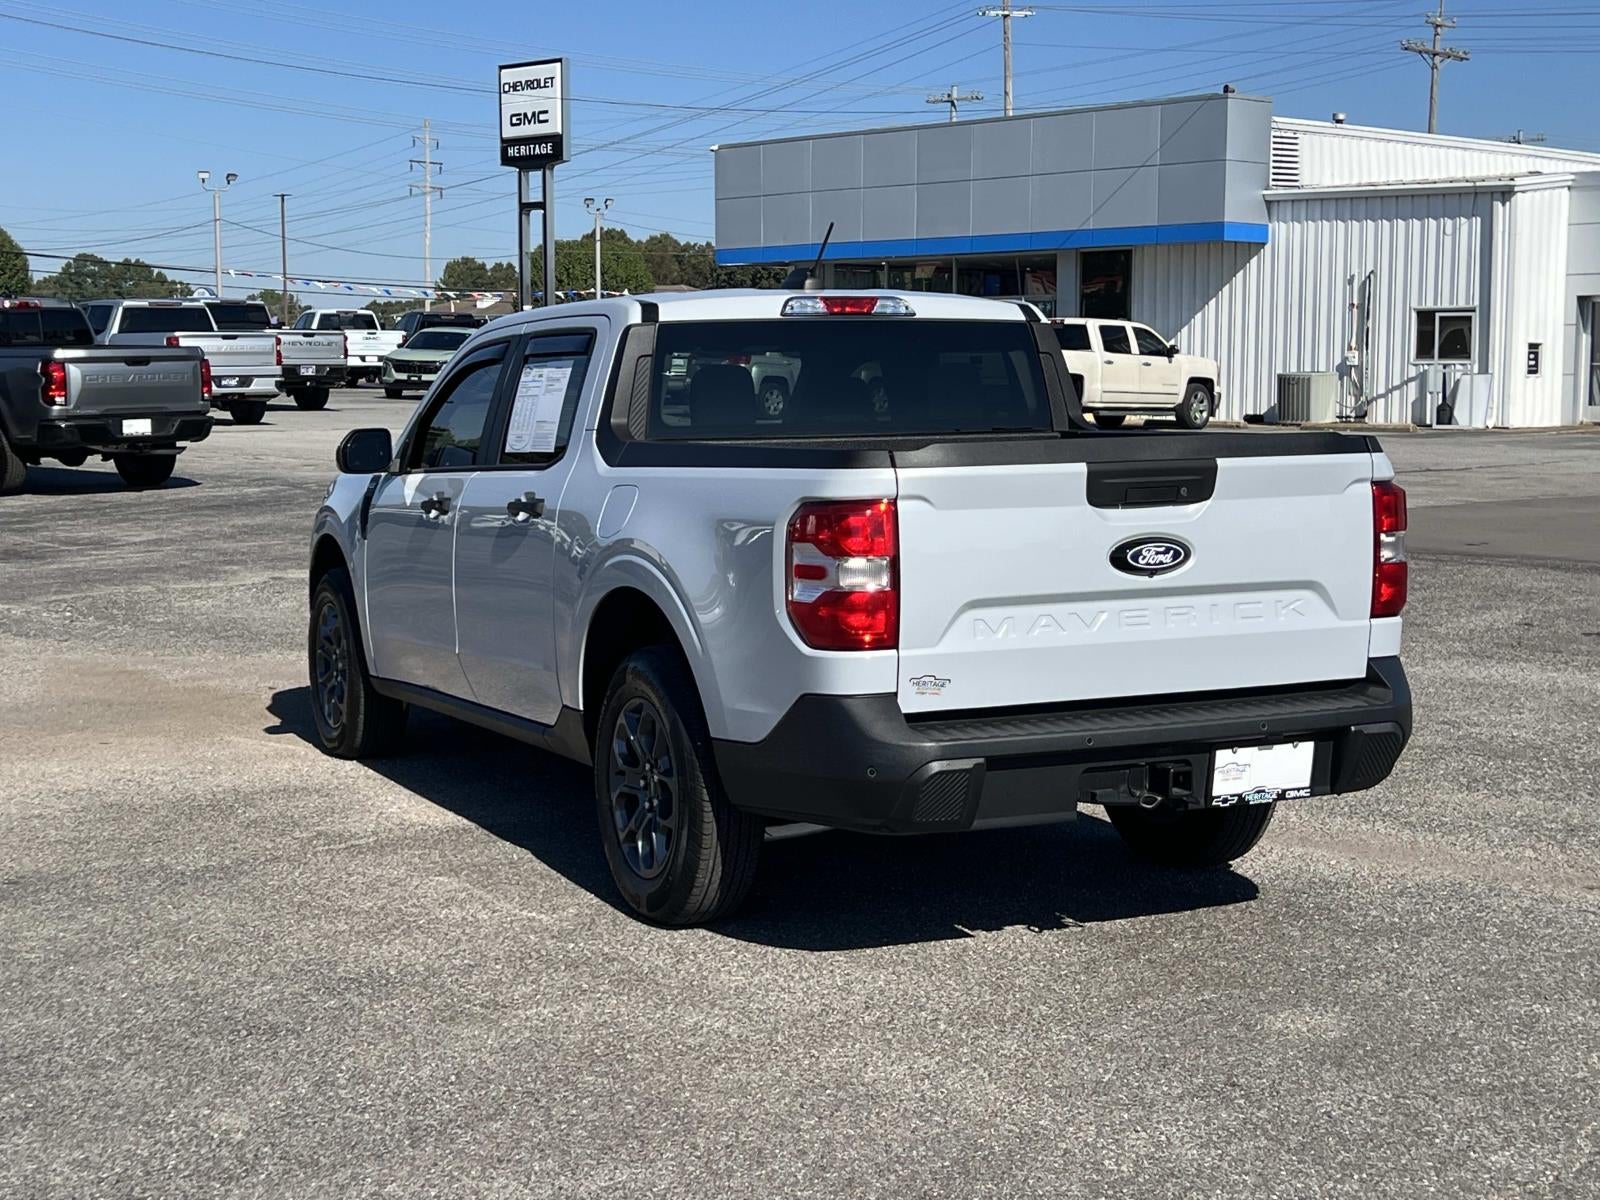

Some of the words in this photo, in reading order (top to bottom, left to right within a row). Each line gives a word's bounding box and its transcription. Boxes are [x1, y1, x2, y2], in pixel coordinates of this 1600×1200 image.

[502, 76, 556, 93] CHEVROLET
[509, 109, 550, 127] GMC
[507, 143, 553, 157] HERITAGE
[1138, 547, 1174, 565] Ford
[973, 599, 1306, 641] MAVERICK
[912, 680, 948, 688] HERITAGE
[1245, 790, 1278, 801] HERITAGE
[1285, 788, 1312, 798] GMC
